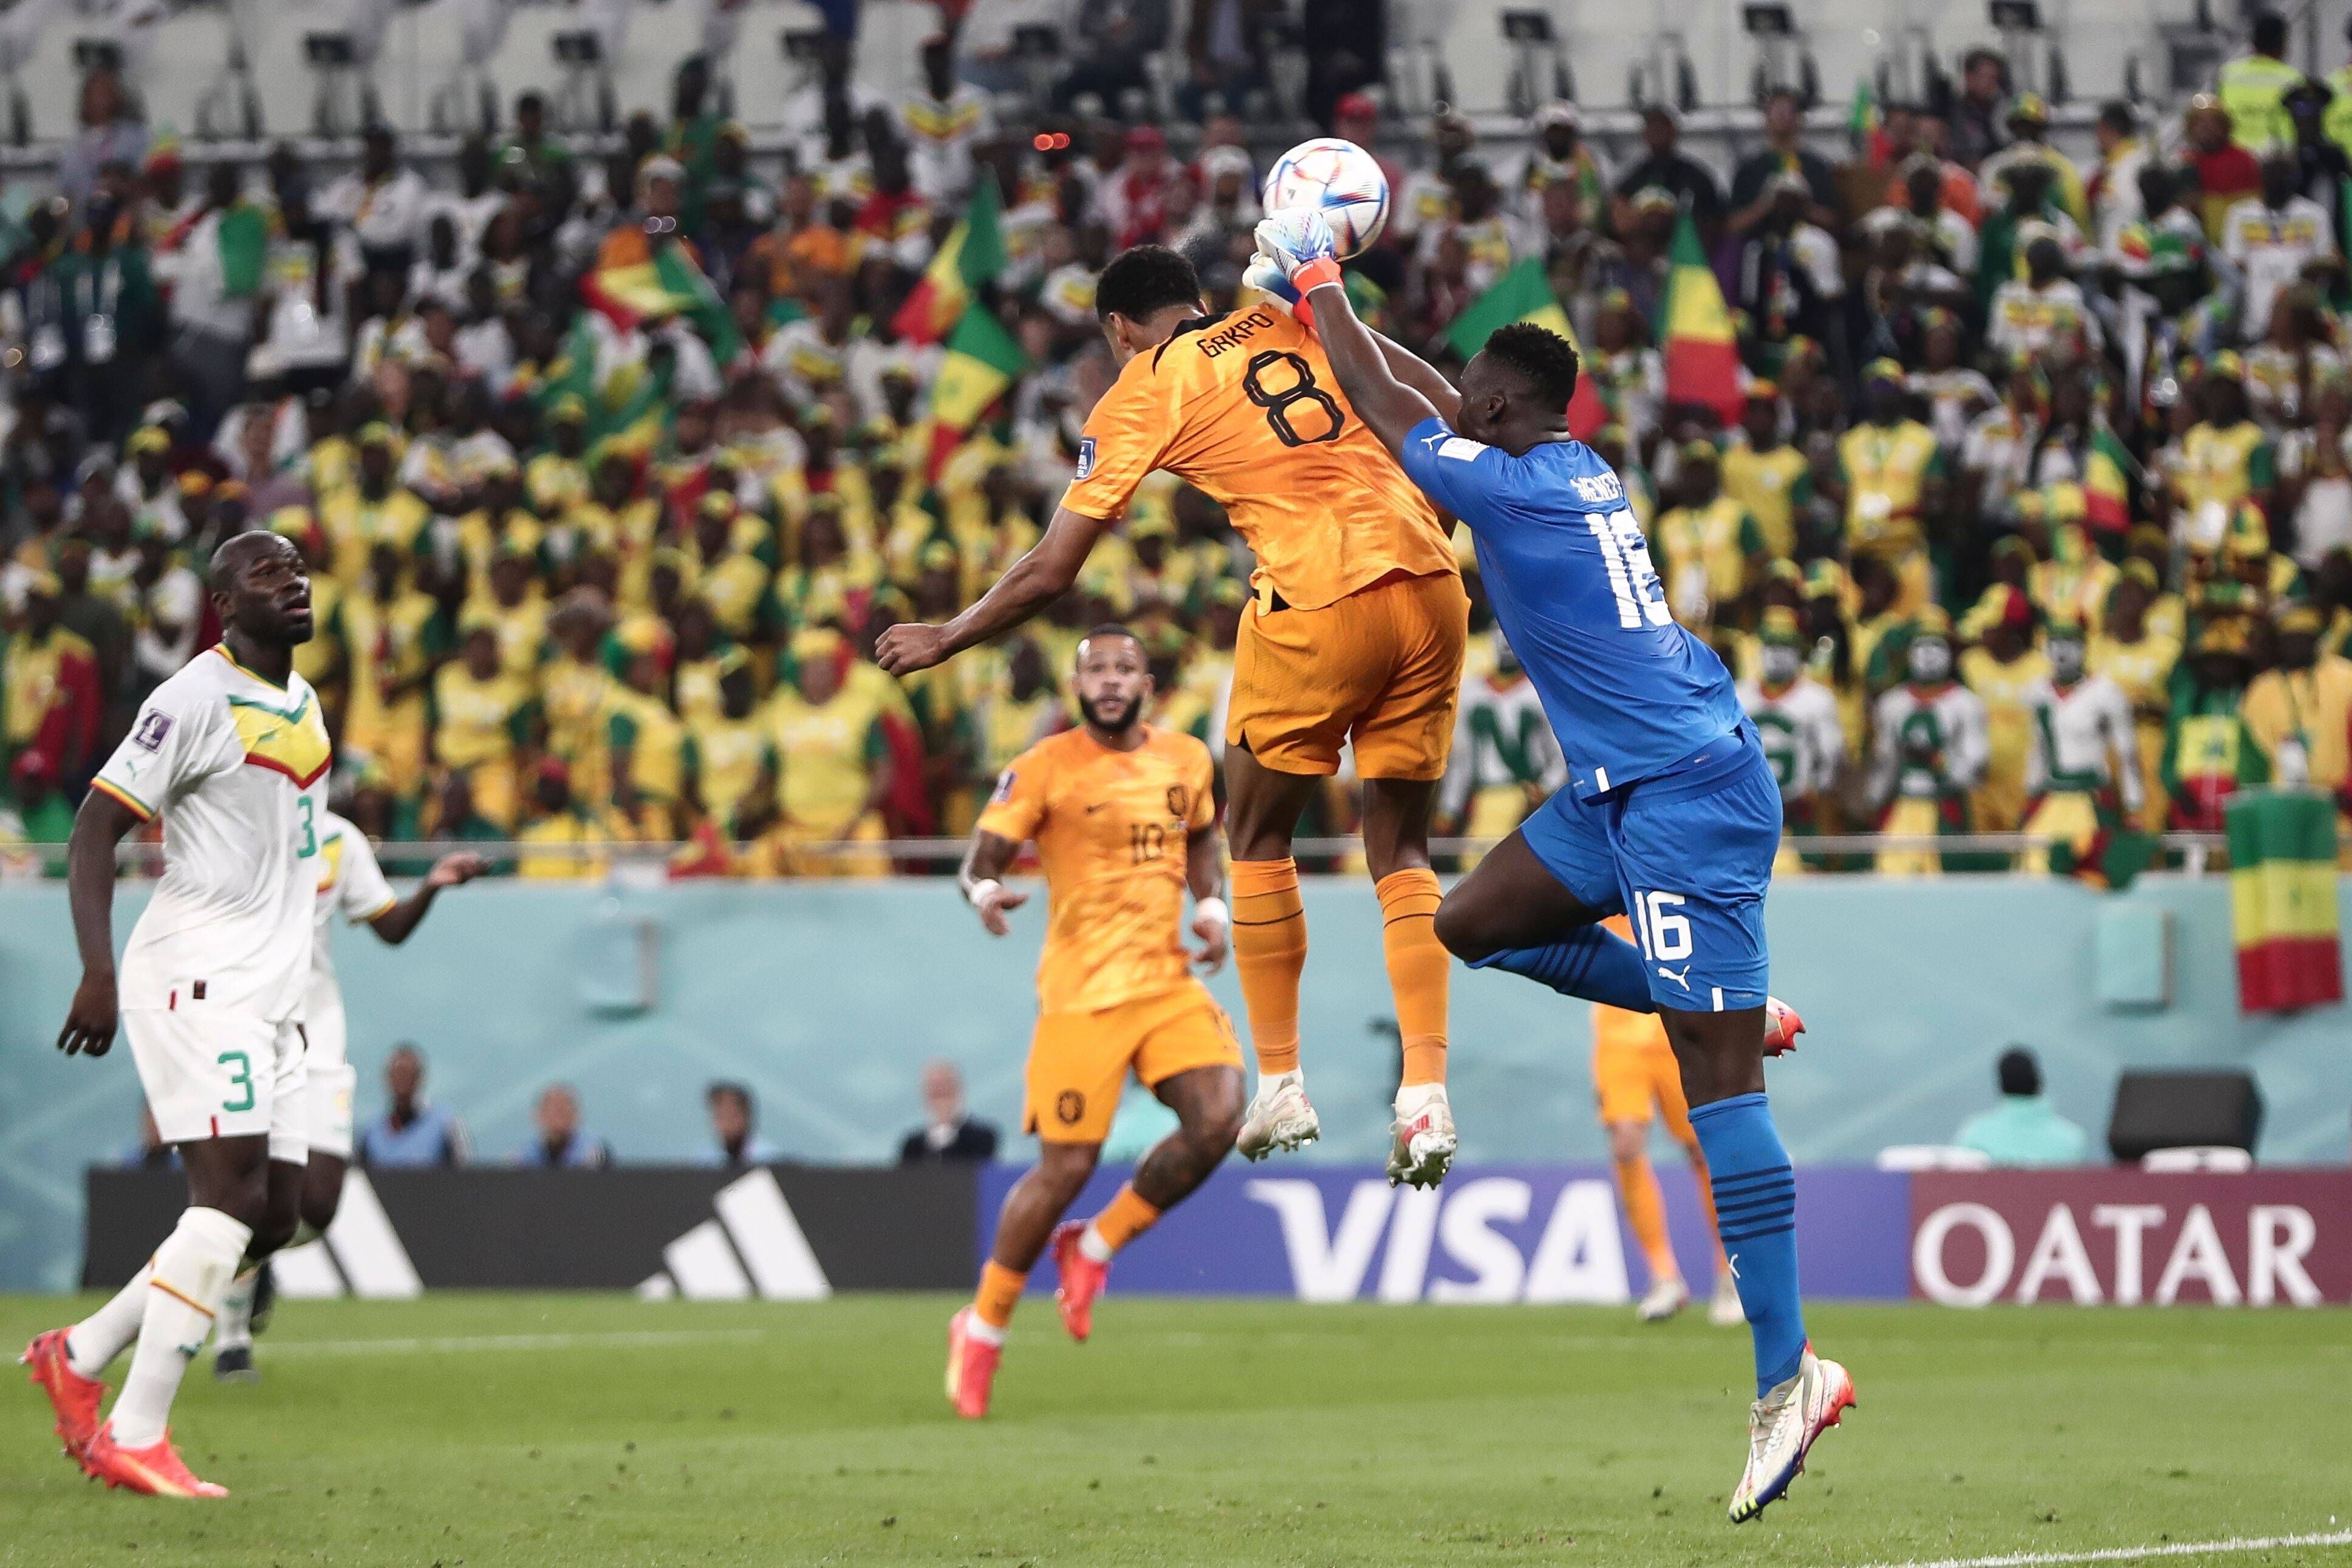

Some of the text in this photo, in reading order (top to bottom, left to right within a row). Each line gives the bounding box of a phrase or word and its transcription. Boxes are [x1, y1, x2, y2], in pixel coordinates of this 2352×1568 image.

[1197, 313, 1274, 358] GAKPO
[1242, 350, 1345, 448] 8
[298, 796, 316, 857] 3
[1129, 822, 1165, 865] 10
[1634, 890, 1694, 962] 16
[218, 1050, 255, 1113] 3
[1245, 1178, 1630, 1303] VISA
